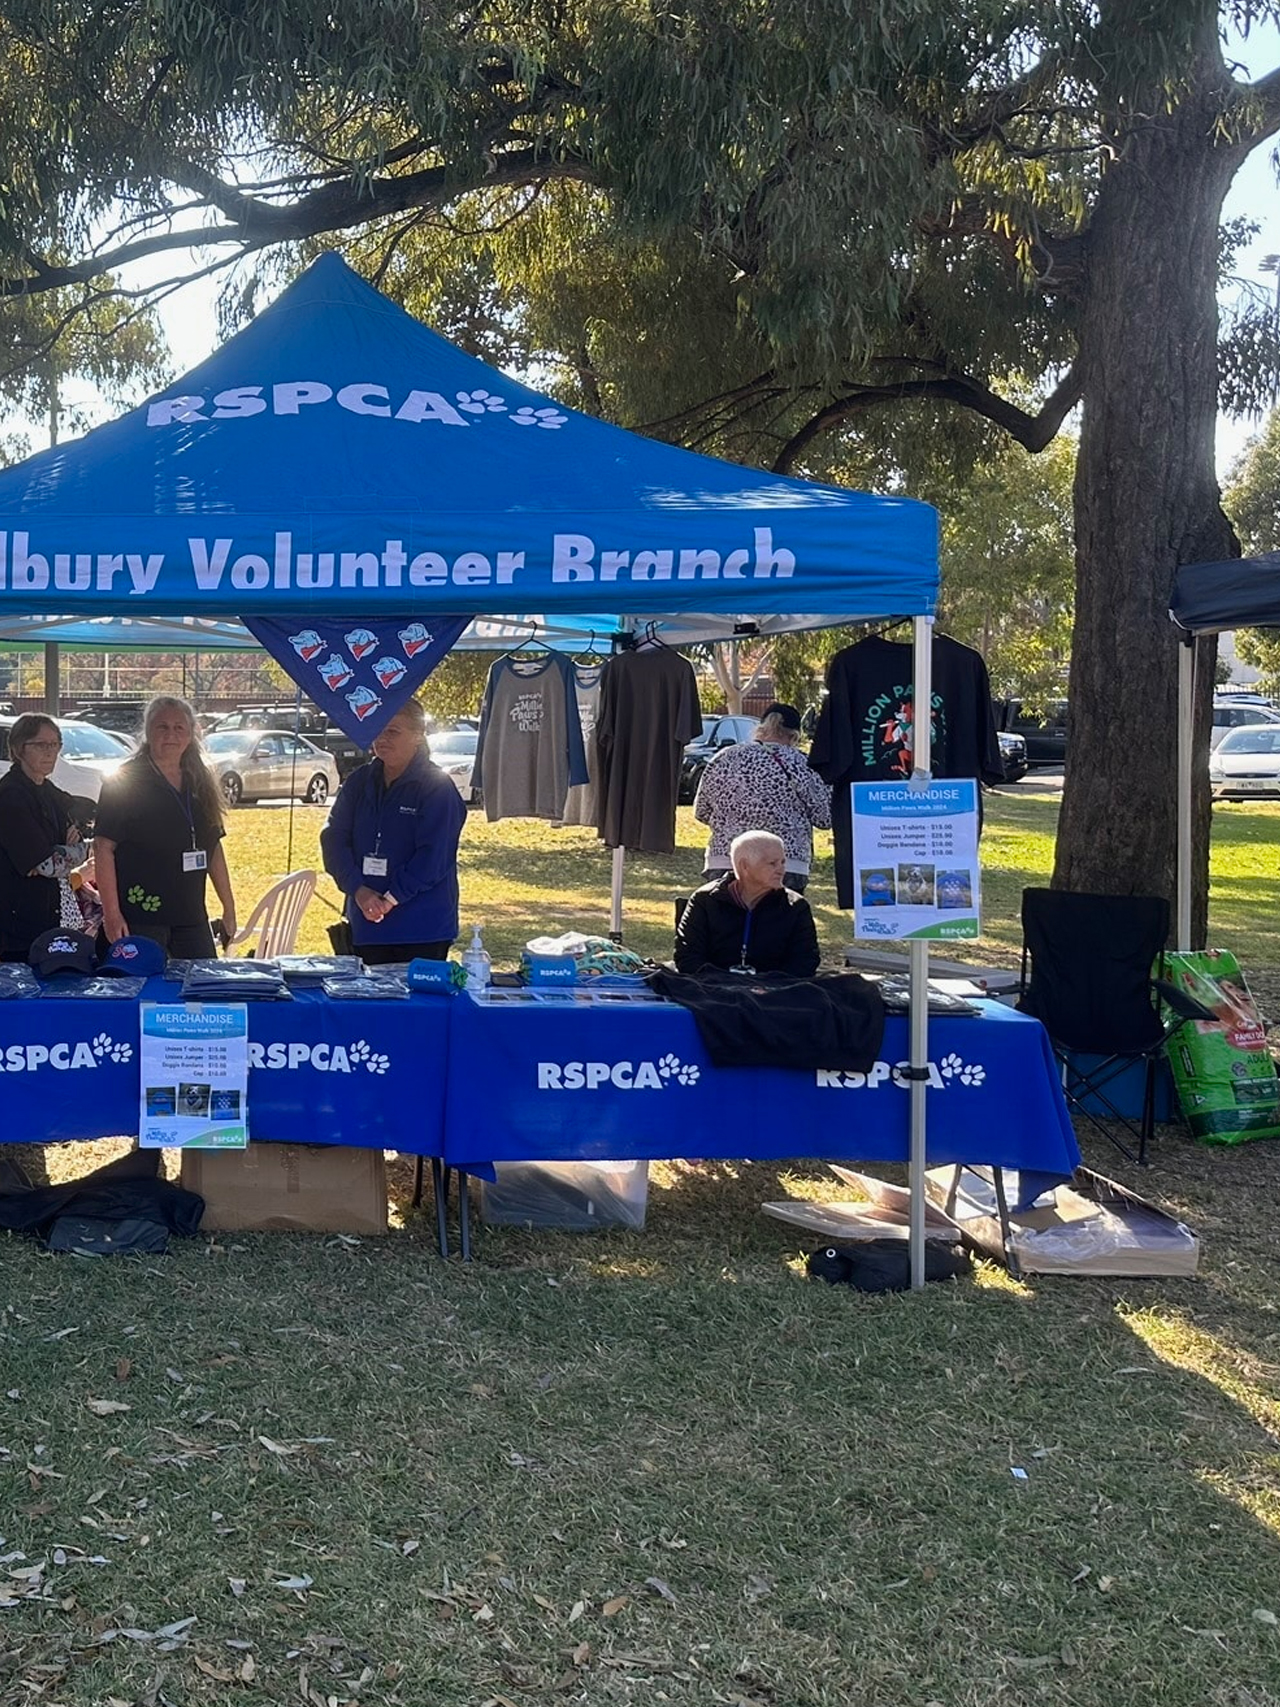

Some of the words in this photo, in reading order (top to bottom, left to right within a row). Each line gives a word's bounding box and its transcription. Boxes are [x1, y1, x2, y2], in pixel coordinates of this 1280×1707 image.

[146, 381, 470, 428] RSPCA
[187, 531, 525, 591] Volunteer
[551, 527, 796, 584] Branch
[510, 707, 538, 721] Paws
[862, 694, 892, 766] MILLION
[893, 685, 944, 708] PAS
[868, 789, 959, 801] MERCHANDISE
[156, 1013, 234, 1024] MERCHANDISE
[248, 1042, 352, 1073] RSPCA
[537, 1061, 663, 1089] RSPCA
